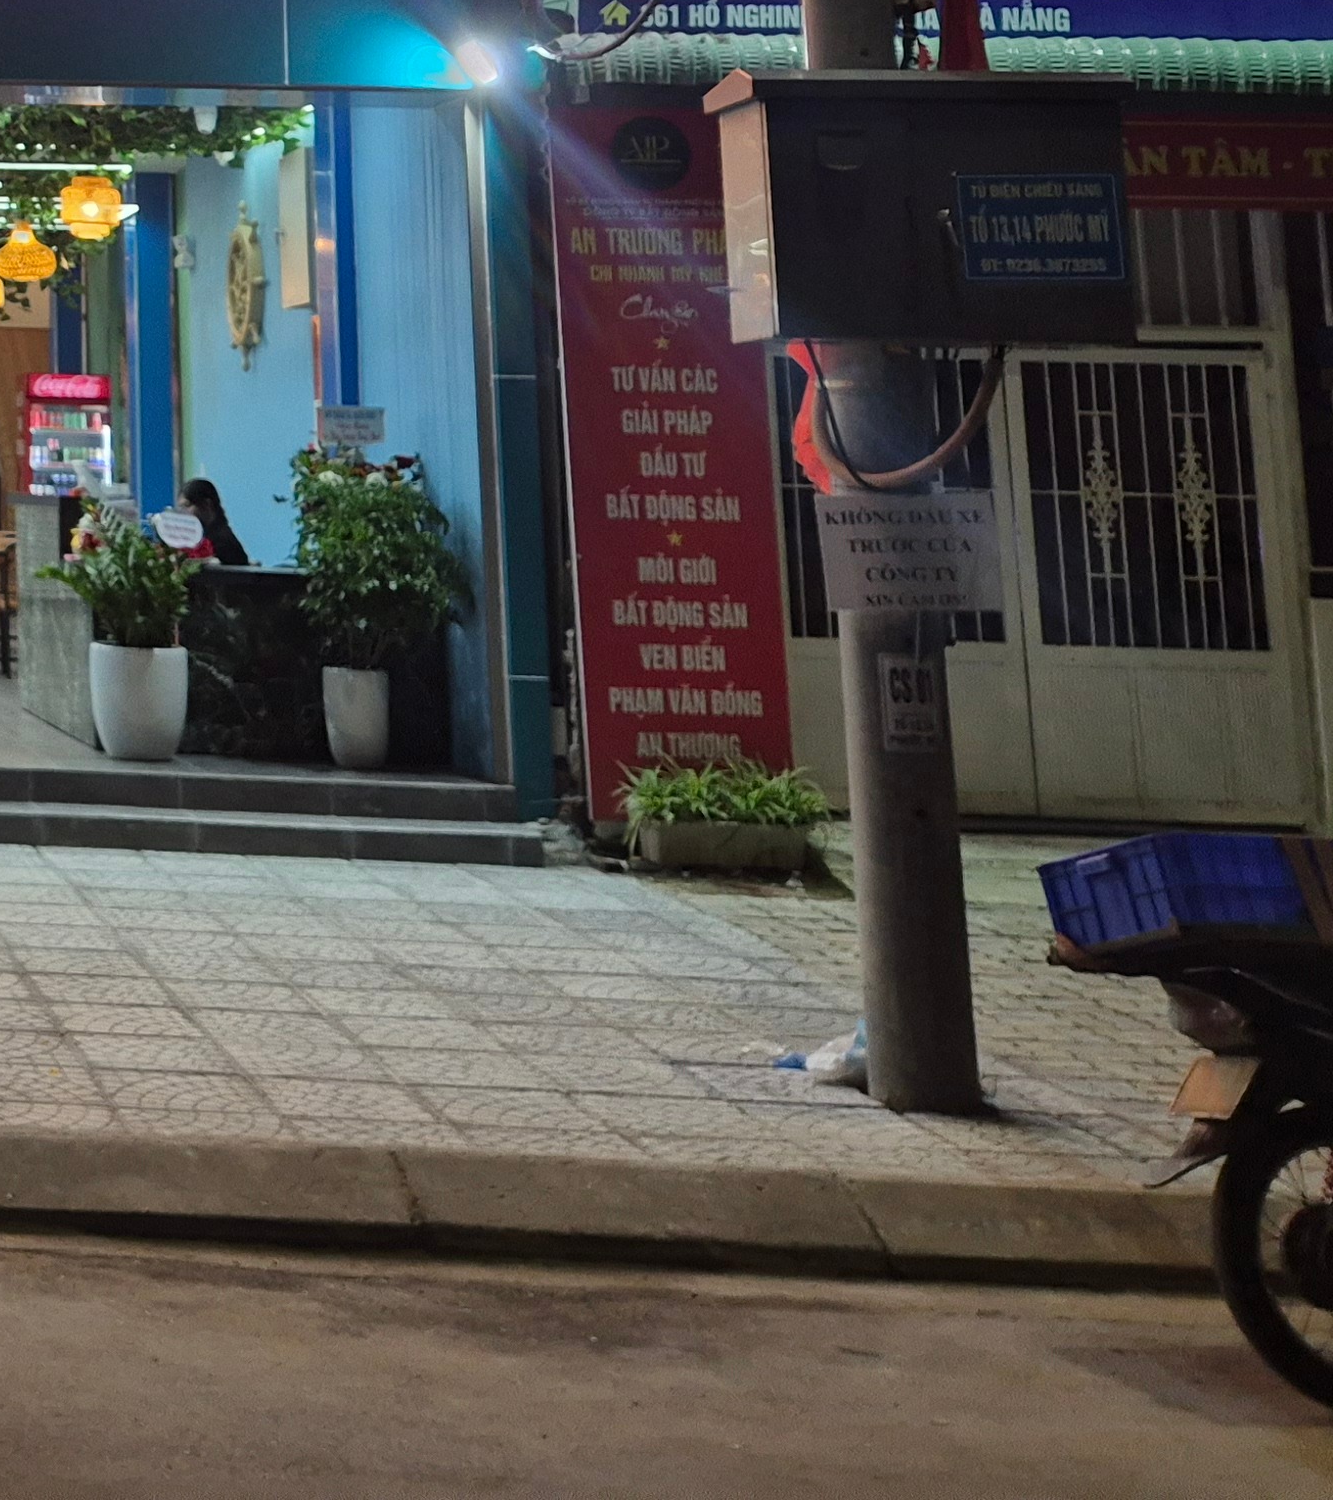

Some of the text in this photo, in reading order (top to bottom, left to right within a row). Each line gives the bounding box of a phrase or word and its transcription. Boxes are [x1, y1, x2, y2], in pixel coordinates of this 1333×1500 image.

[726, 4, 803, 29] NGHIN
[1181, 137, 1272, 178] TÂM
[570, 227, 598, 255] AN
[663, 404, 713, 436] PHÁP
[701, 487, 741, 522] SẢN
[639, 644, 678, 671] VEN
[608, 686, 665, 719] PHẠM
[637, 731, 664, 758] AN
